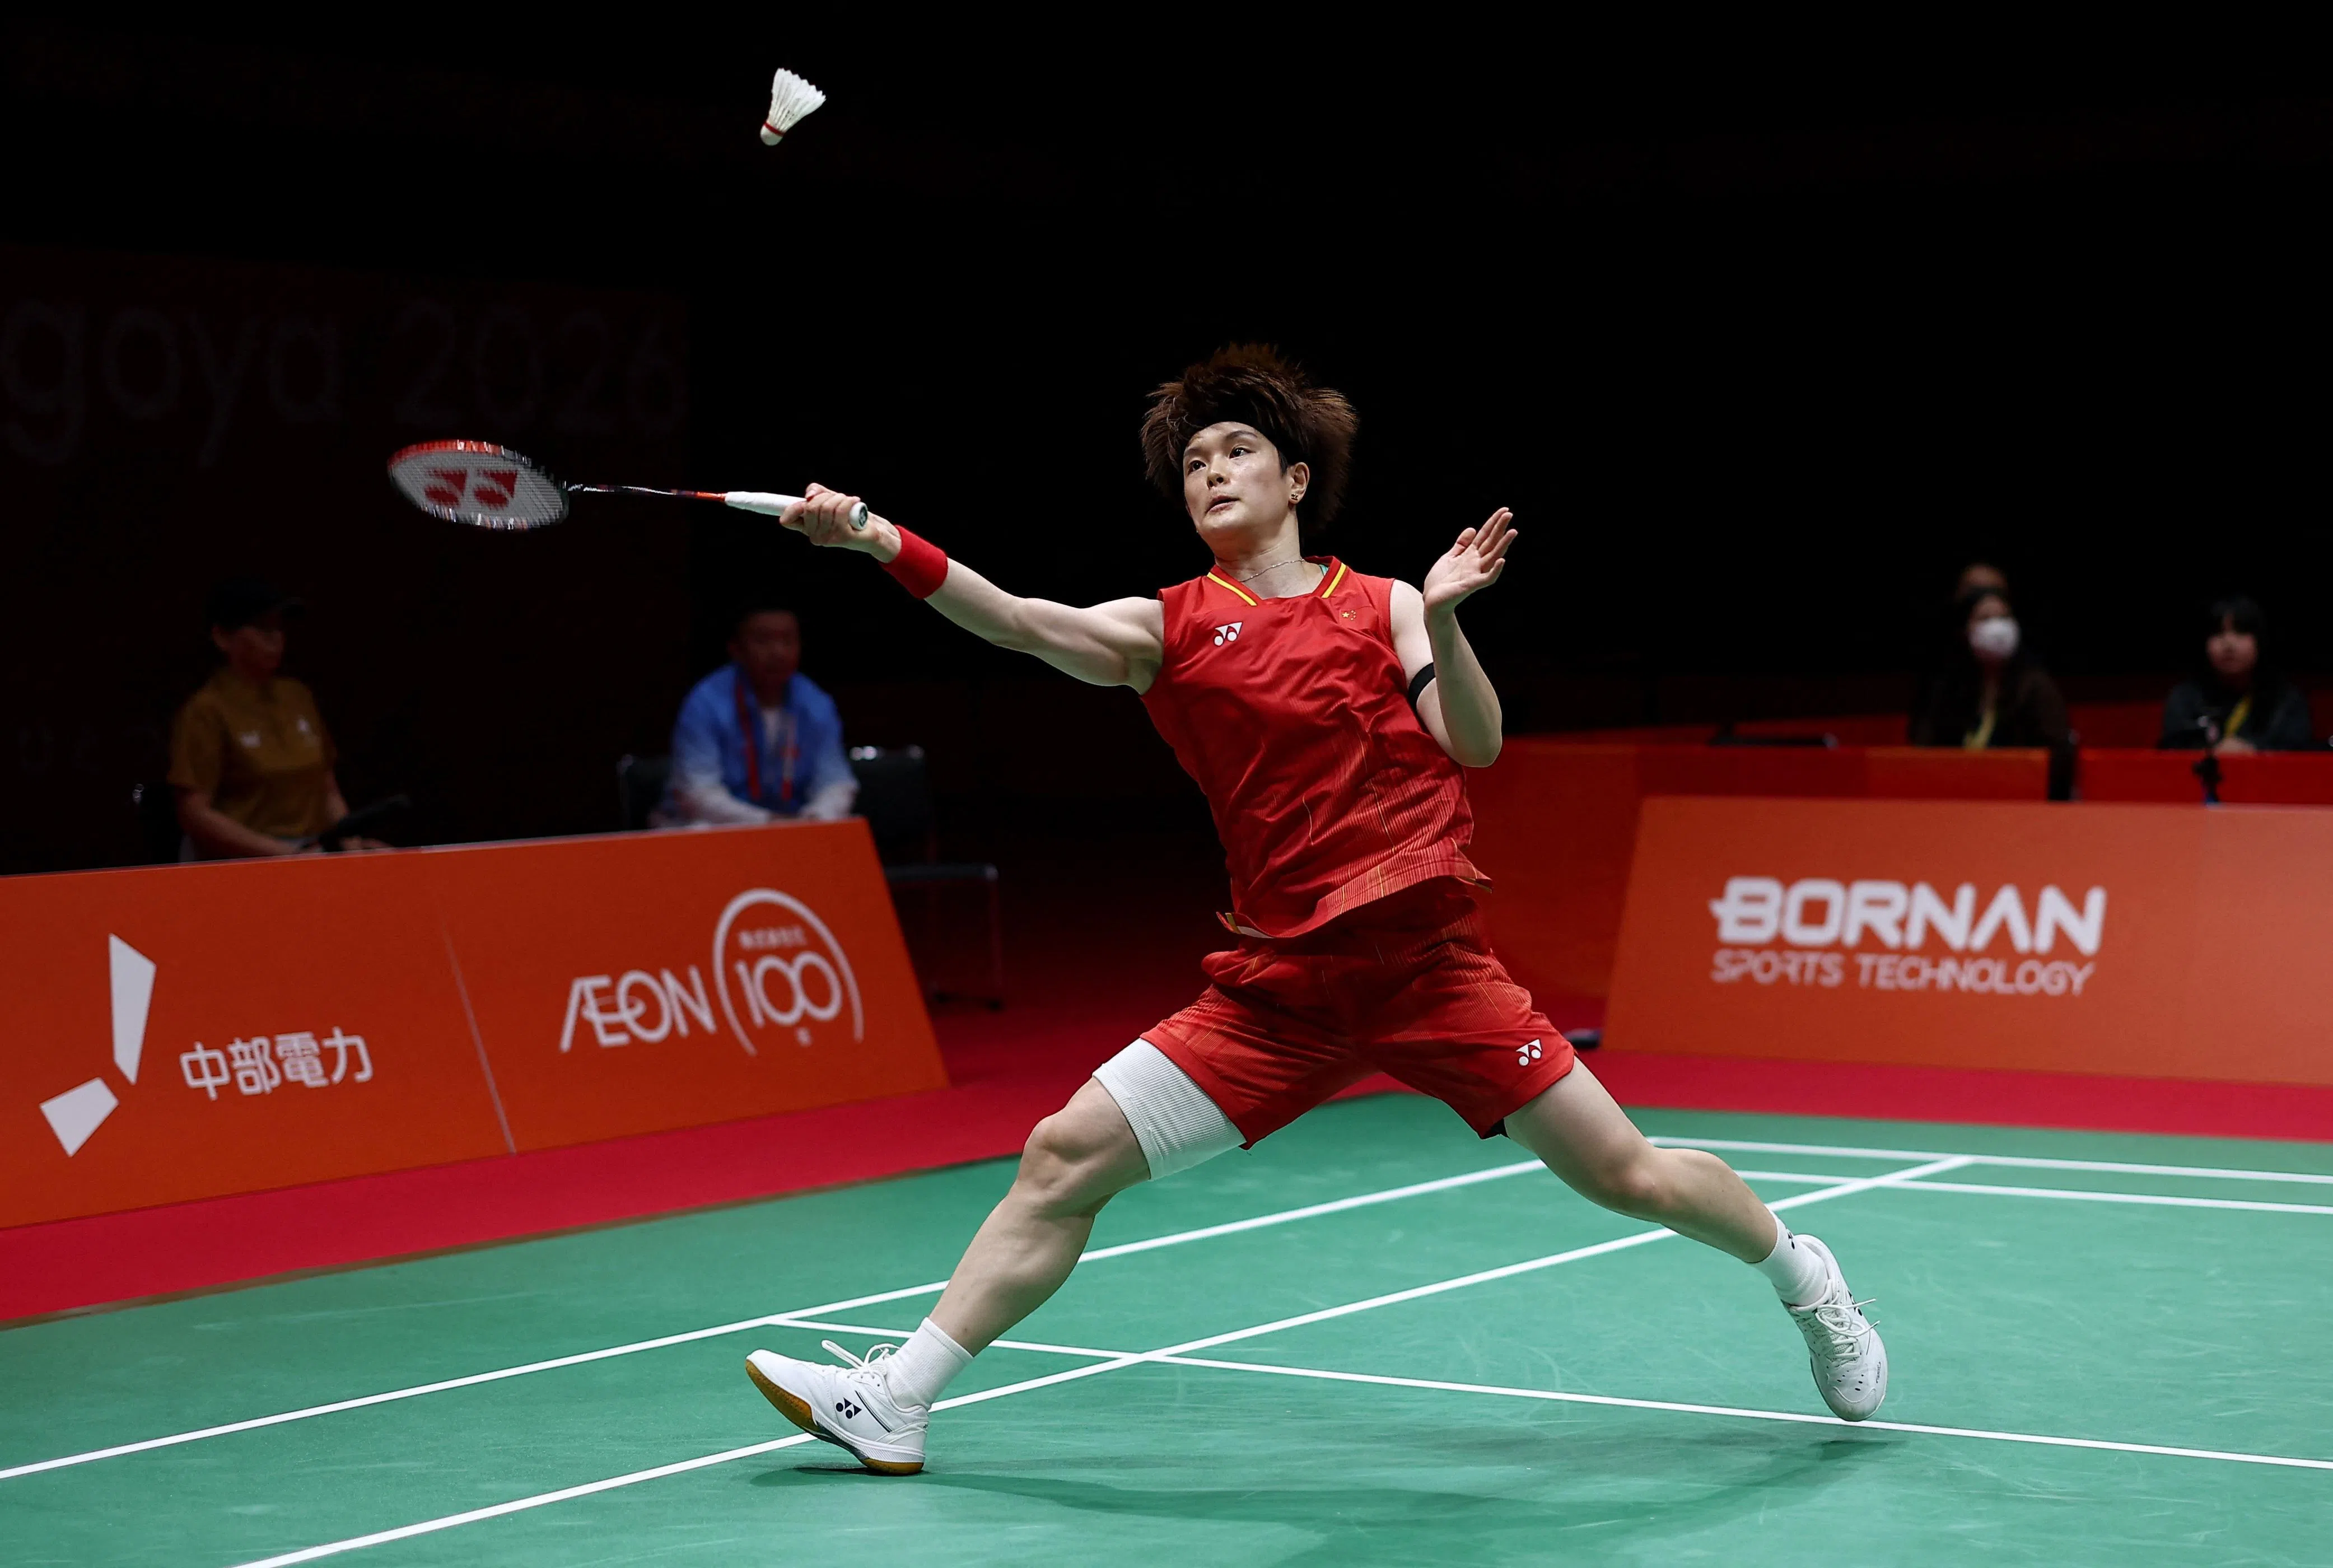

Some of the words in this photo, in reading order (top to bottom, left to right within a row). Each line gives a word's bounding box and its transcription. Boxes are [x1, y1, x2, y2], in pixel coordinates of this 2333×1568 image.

[393, 296, 687, 436] 2026
[1709, 876, 2107, 956] BORNAN
[1711, 948, 1845, 988] SPORTS
[1854, 952, 2096, 996] TECHNOLOGY
[179, 1026, 374, 1101] 中部電力
